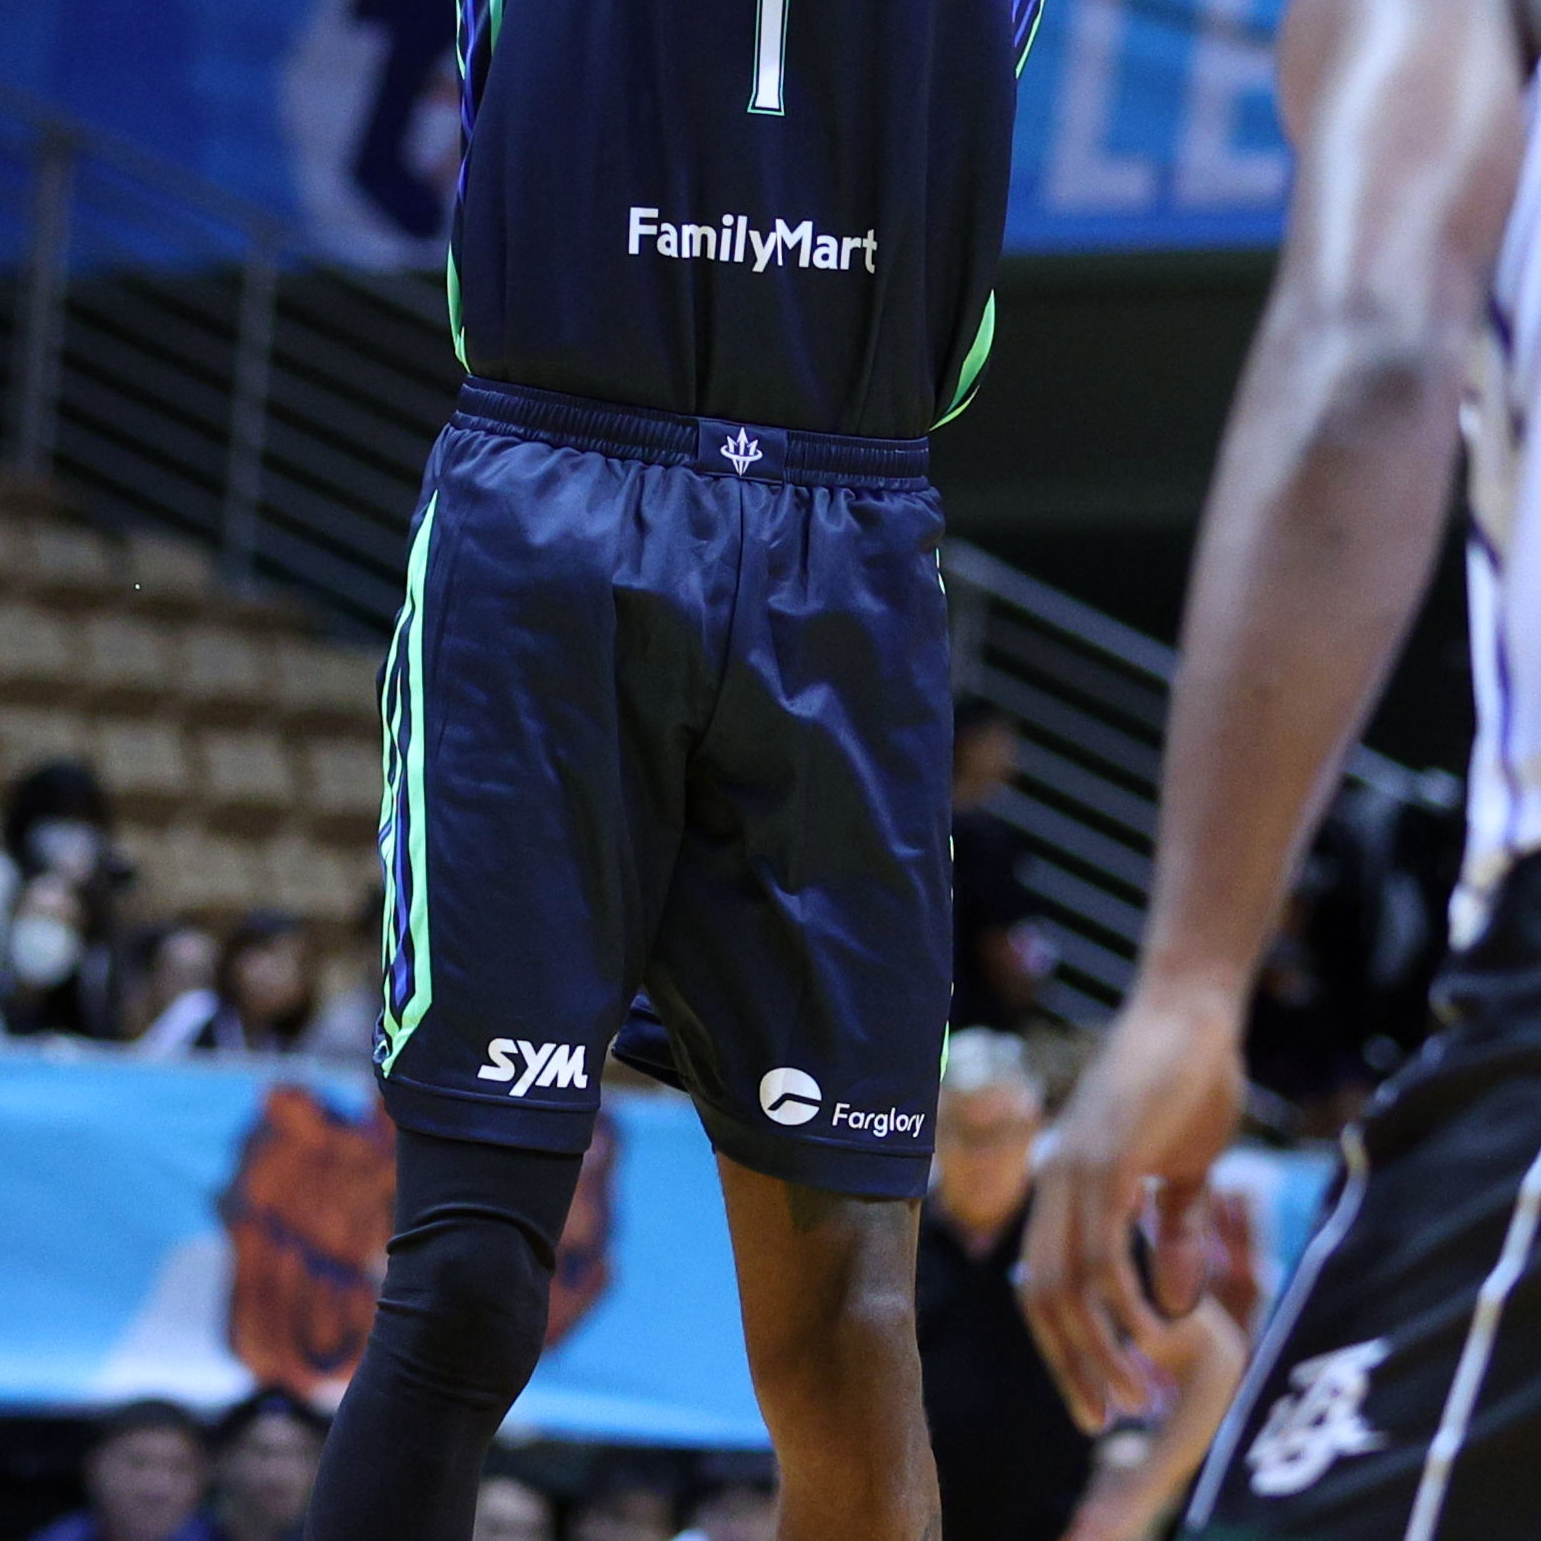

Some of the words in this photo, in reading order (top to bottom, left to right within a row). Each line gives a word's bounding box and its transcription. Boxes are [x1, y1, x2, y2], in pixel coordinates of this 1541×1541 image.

[628, 206, 878, 275] FamilyMart
[477, 1037, 588, 1097] SYM
[831, 1101, 926, 1139] Farglory
